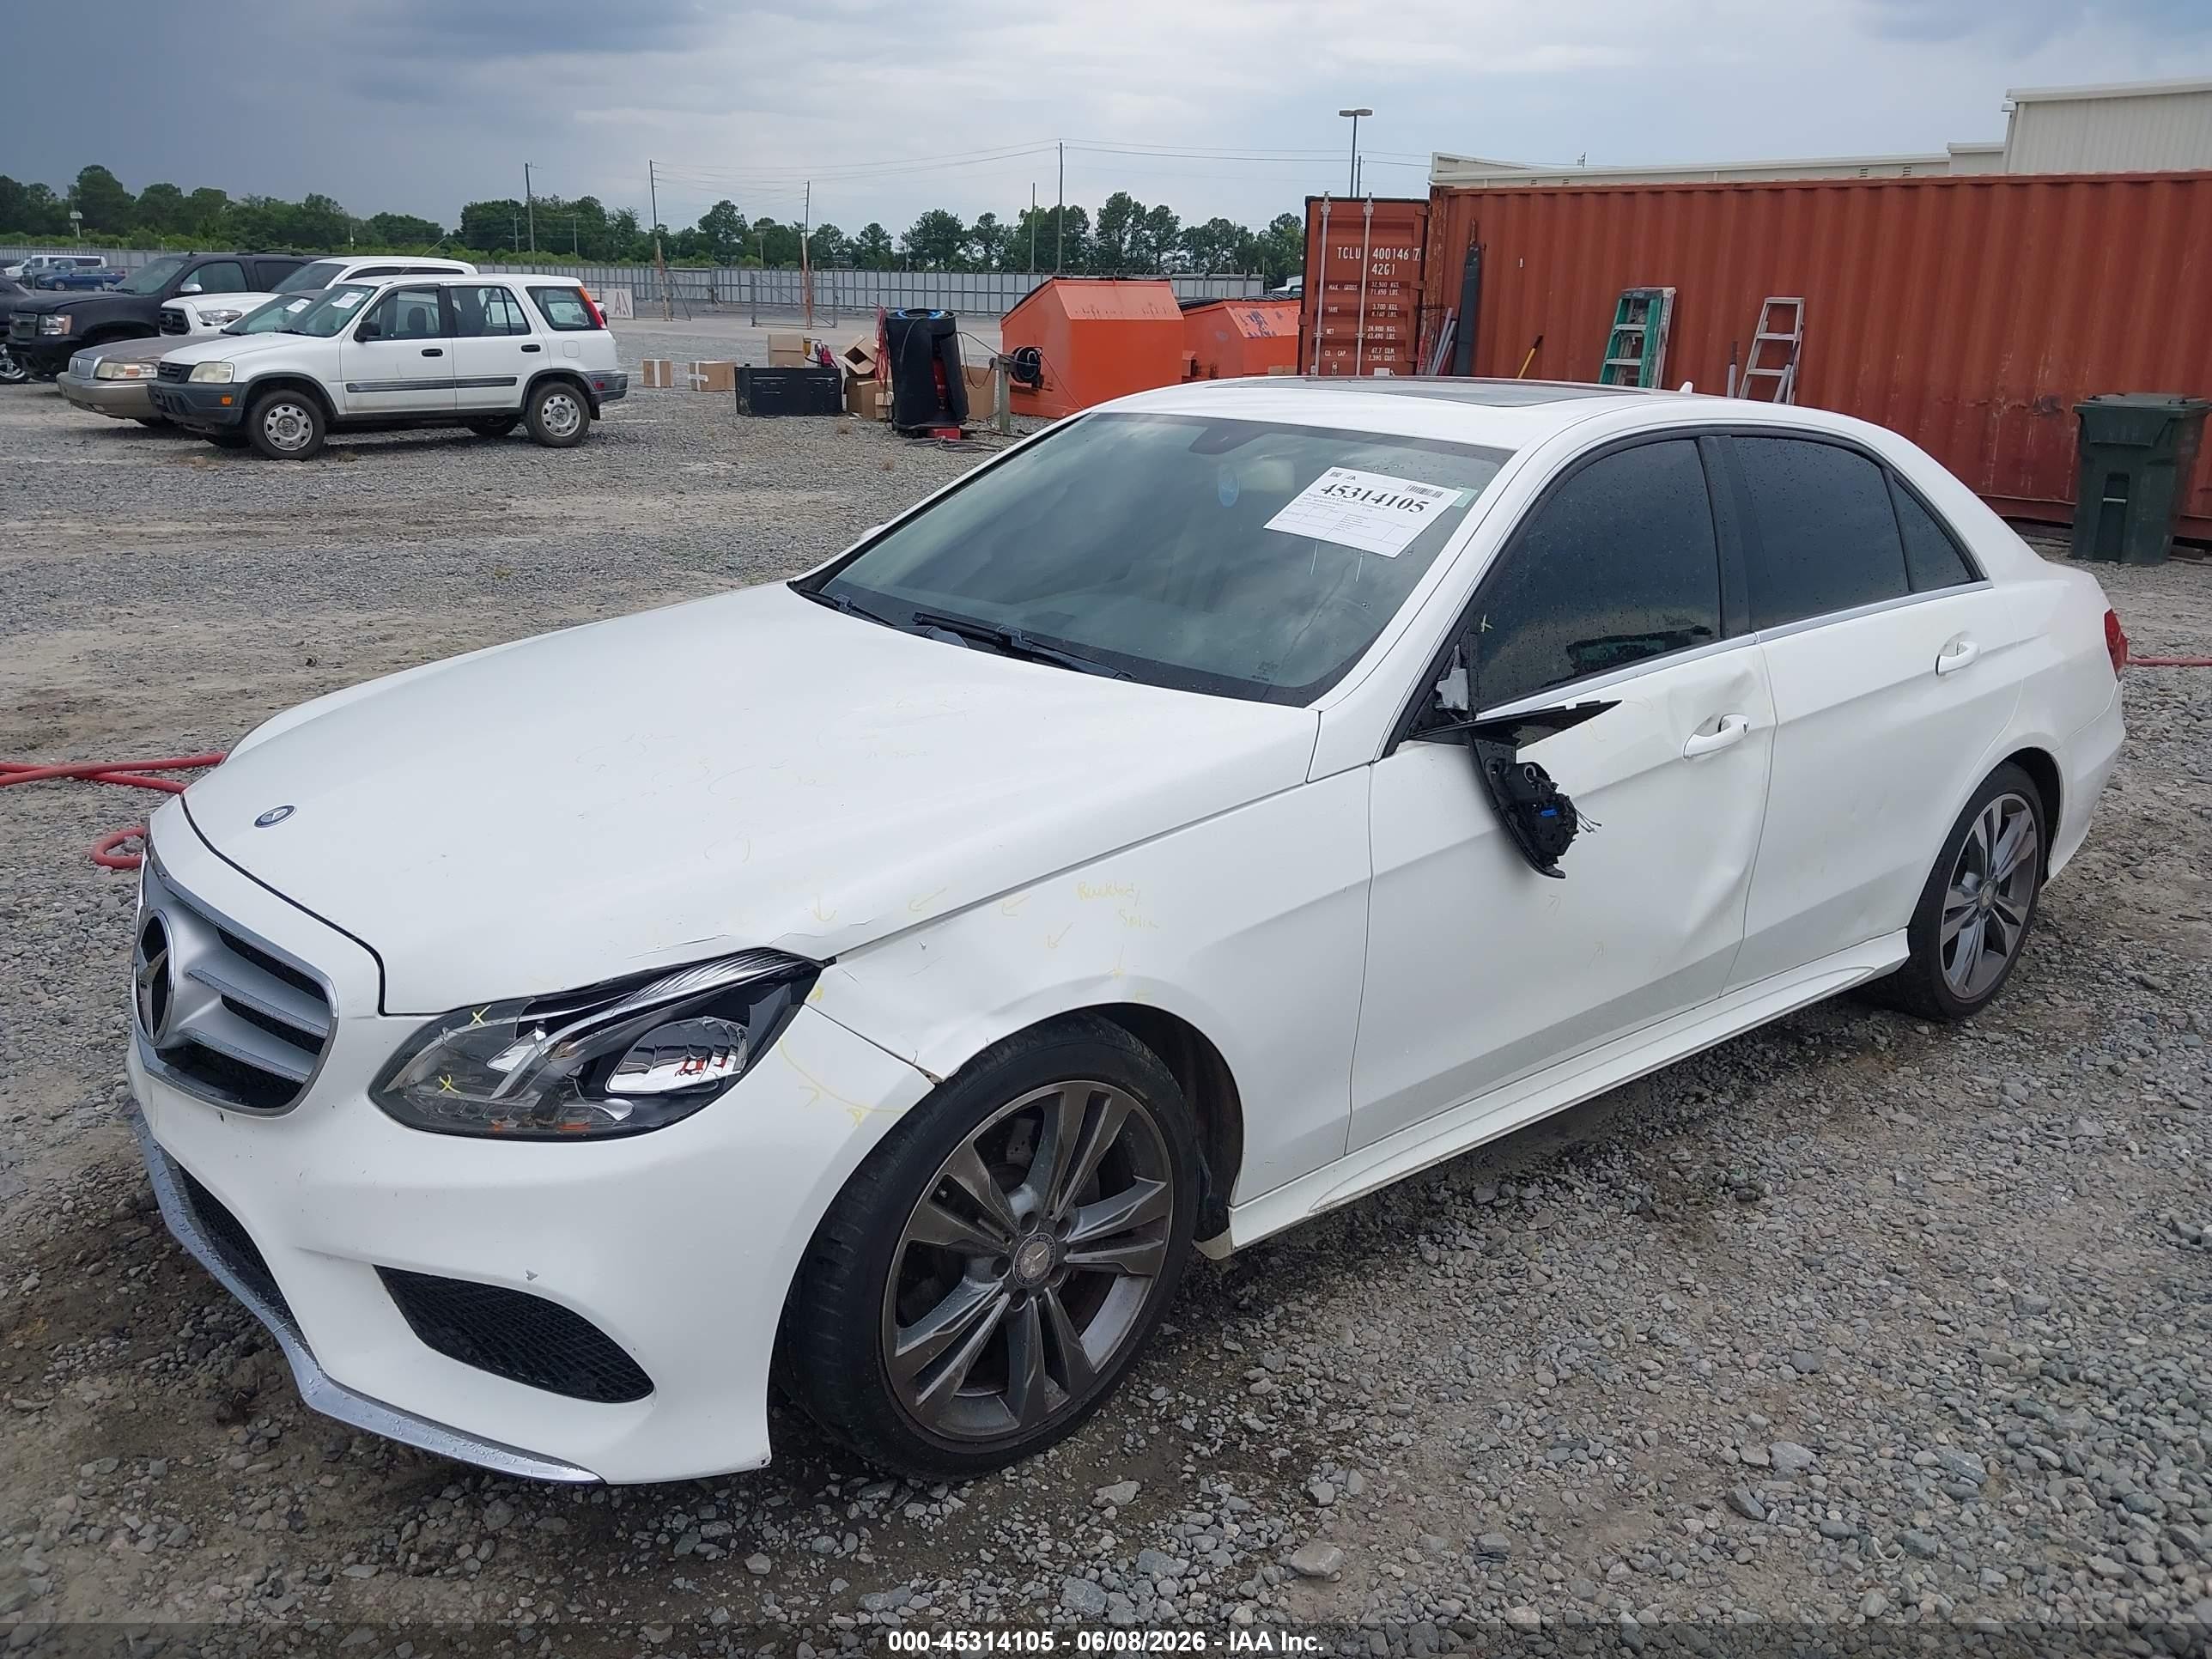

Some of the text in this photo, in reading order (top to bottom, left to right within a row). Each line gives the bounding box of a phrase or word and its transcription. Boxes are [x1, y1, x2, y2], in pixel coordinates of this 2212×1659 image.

[1337, 246, 1421, 261] TCLU 400146 7
[1371, 263, 1395, 276] 42G1
[1321, 483, 1431, 514] 45314105
